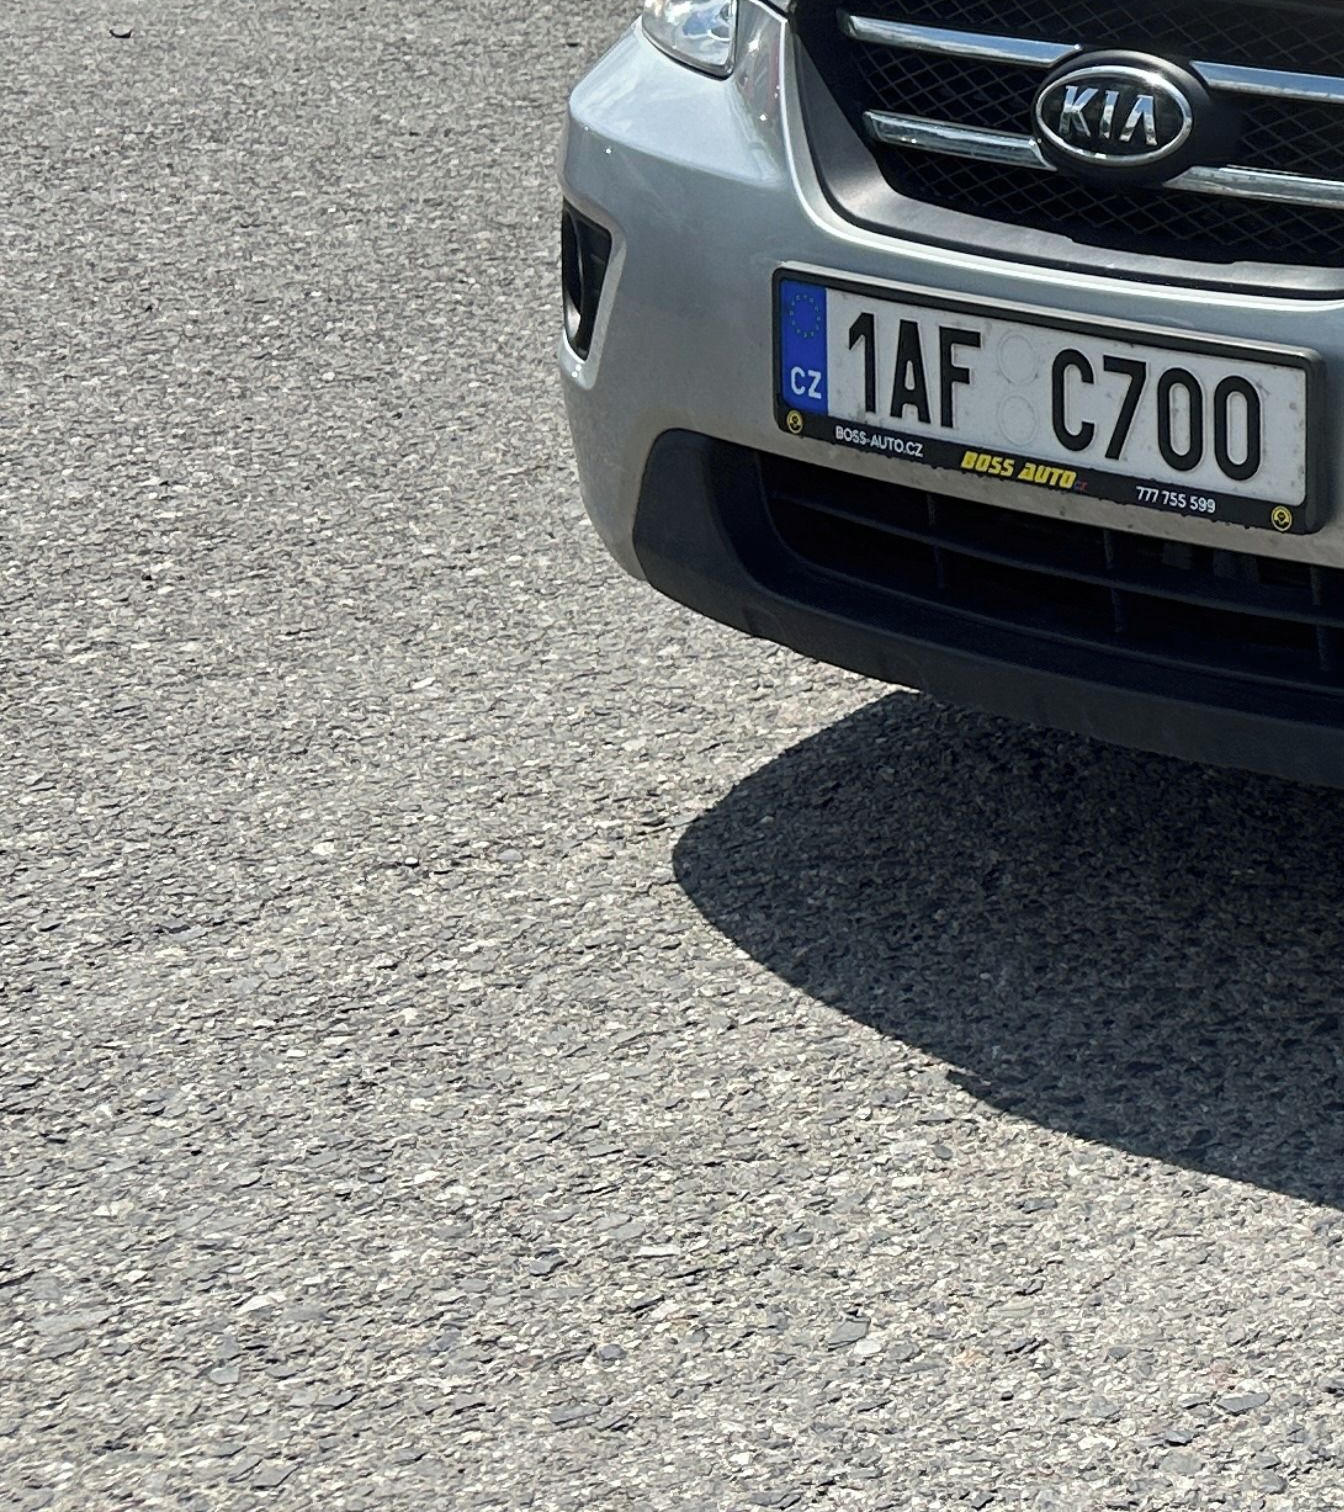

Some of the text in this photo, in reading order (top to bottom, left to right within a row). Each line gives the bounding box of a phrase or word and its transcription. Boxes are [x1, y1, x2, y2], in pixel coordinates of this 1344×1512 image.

[1058, 84, 1157, 146] KIA
[790, 366, 822, 400] CZ
[848, 312, 1262, 481] 1AF C700
[835, 425, 924, 458] BOSS-AUTO.CZ
[960, 450, 1014, 477] BOSS
[1017, 462, 1077, 488] AUTO
[1135, 485, 1216, 514] 777 755 599
